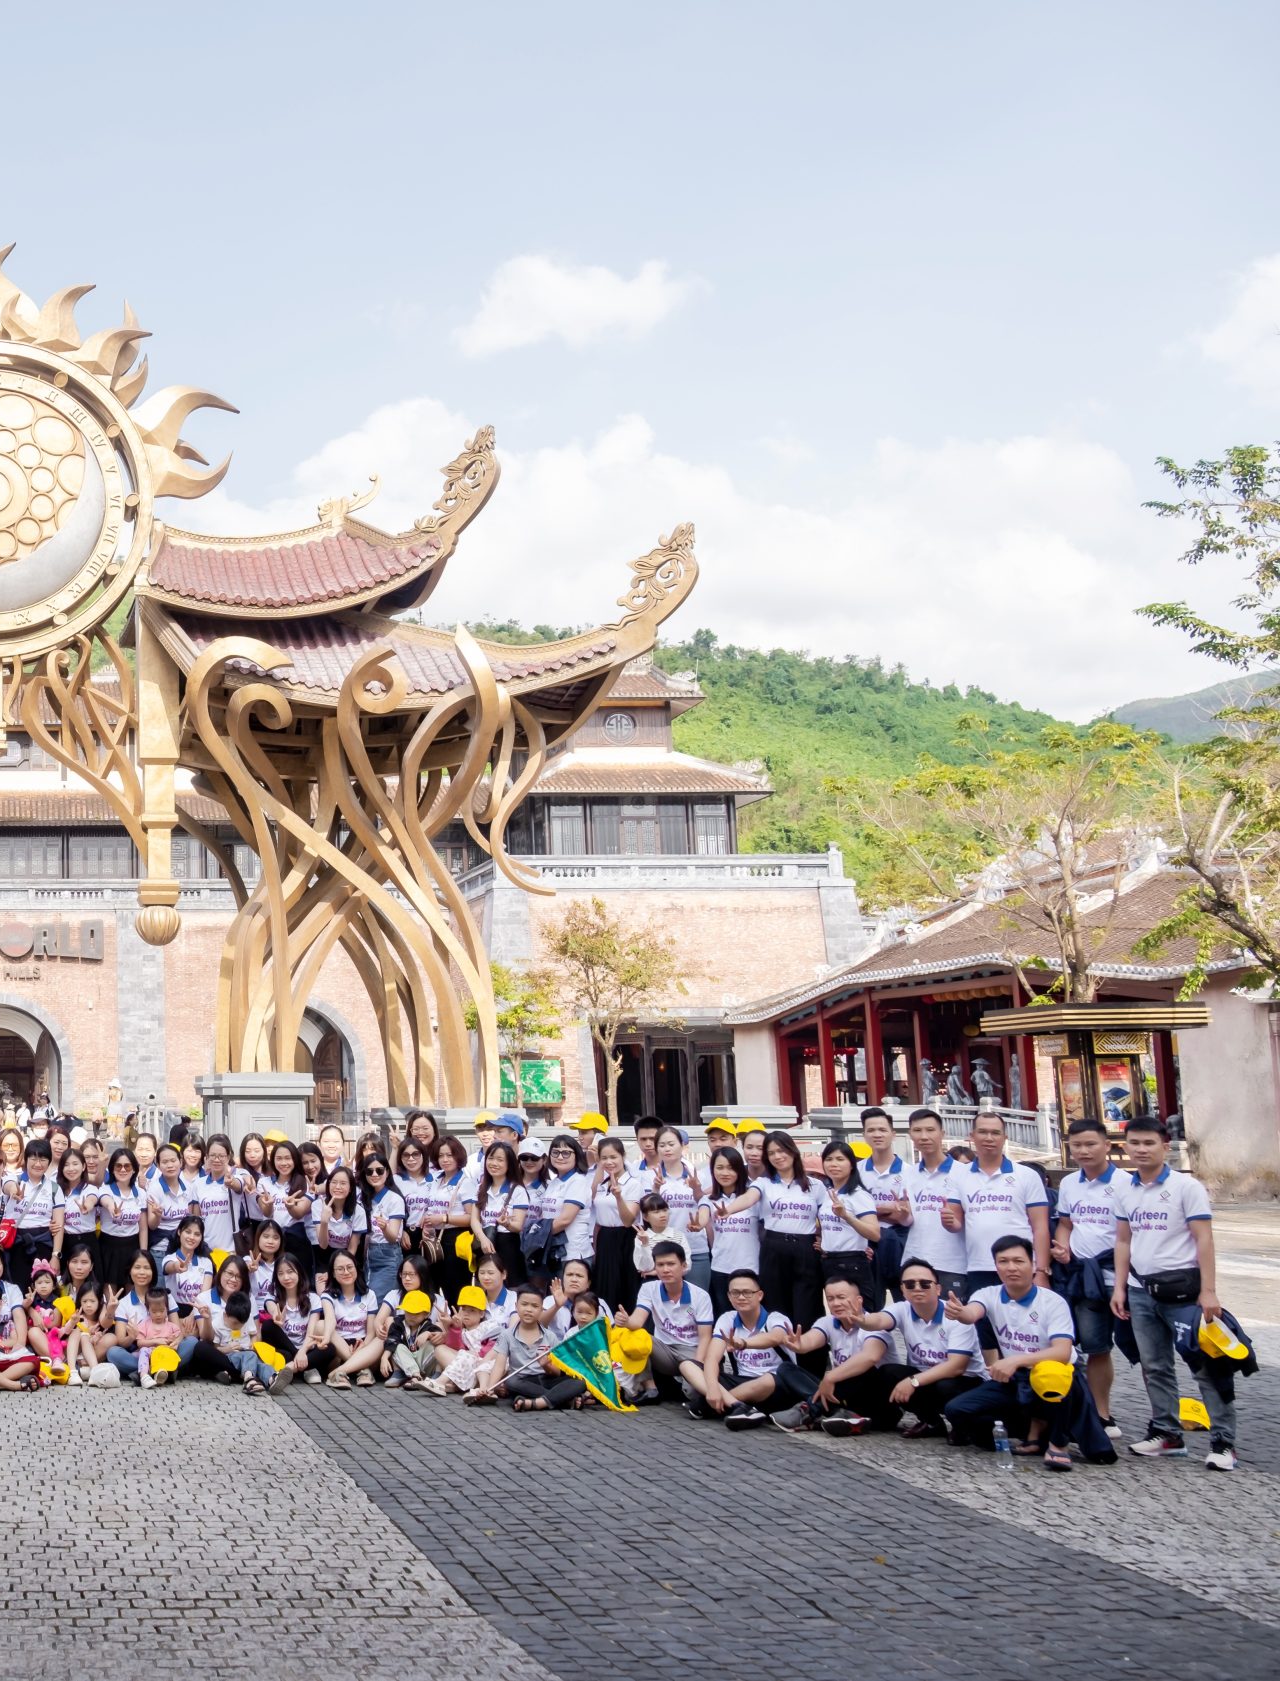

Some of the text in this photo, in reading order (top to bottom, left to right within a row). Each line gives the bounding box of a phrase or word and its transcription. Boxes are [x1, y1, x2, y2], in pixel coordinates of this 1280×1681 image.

[3, 966, 40, 981] HILLS
[967, 1190, 1012, 1204] Vipteen
[770, 1198, 811, 1211] Vipteen
[1070, 1200, 1109, 1215] Vipteen
